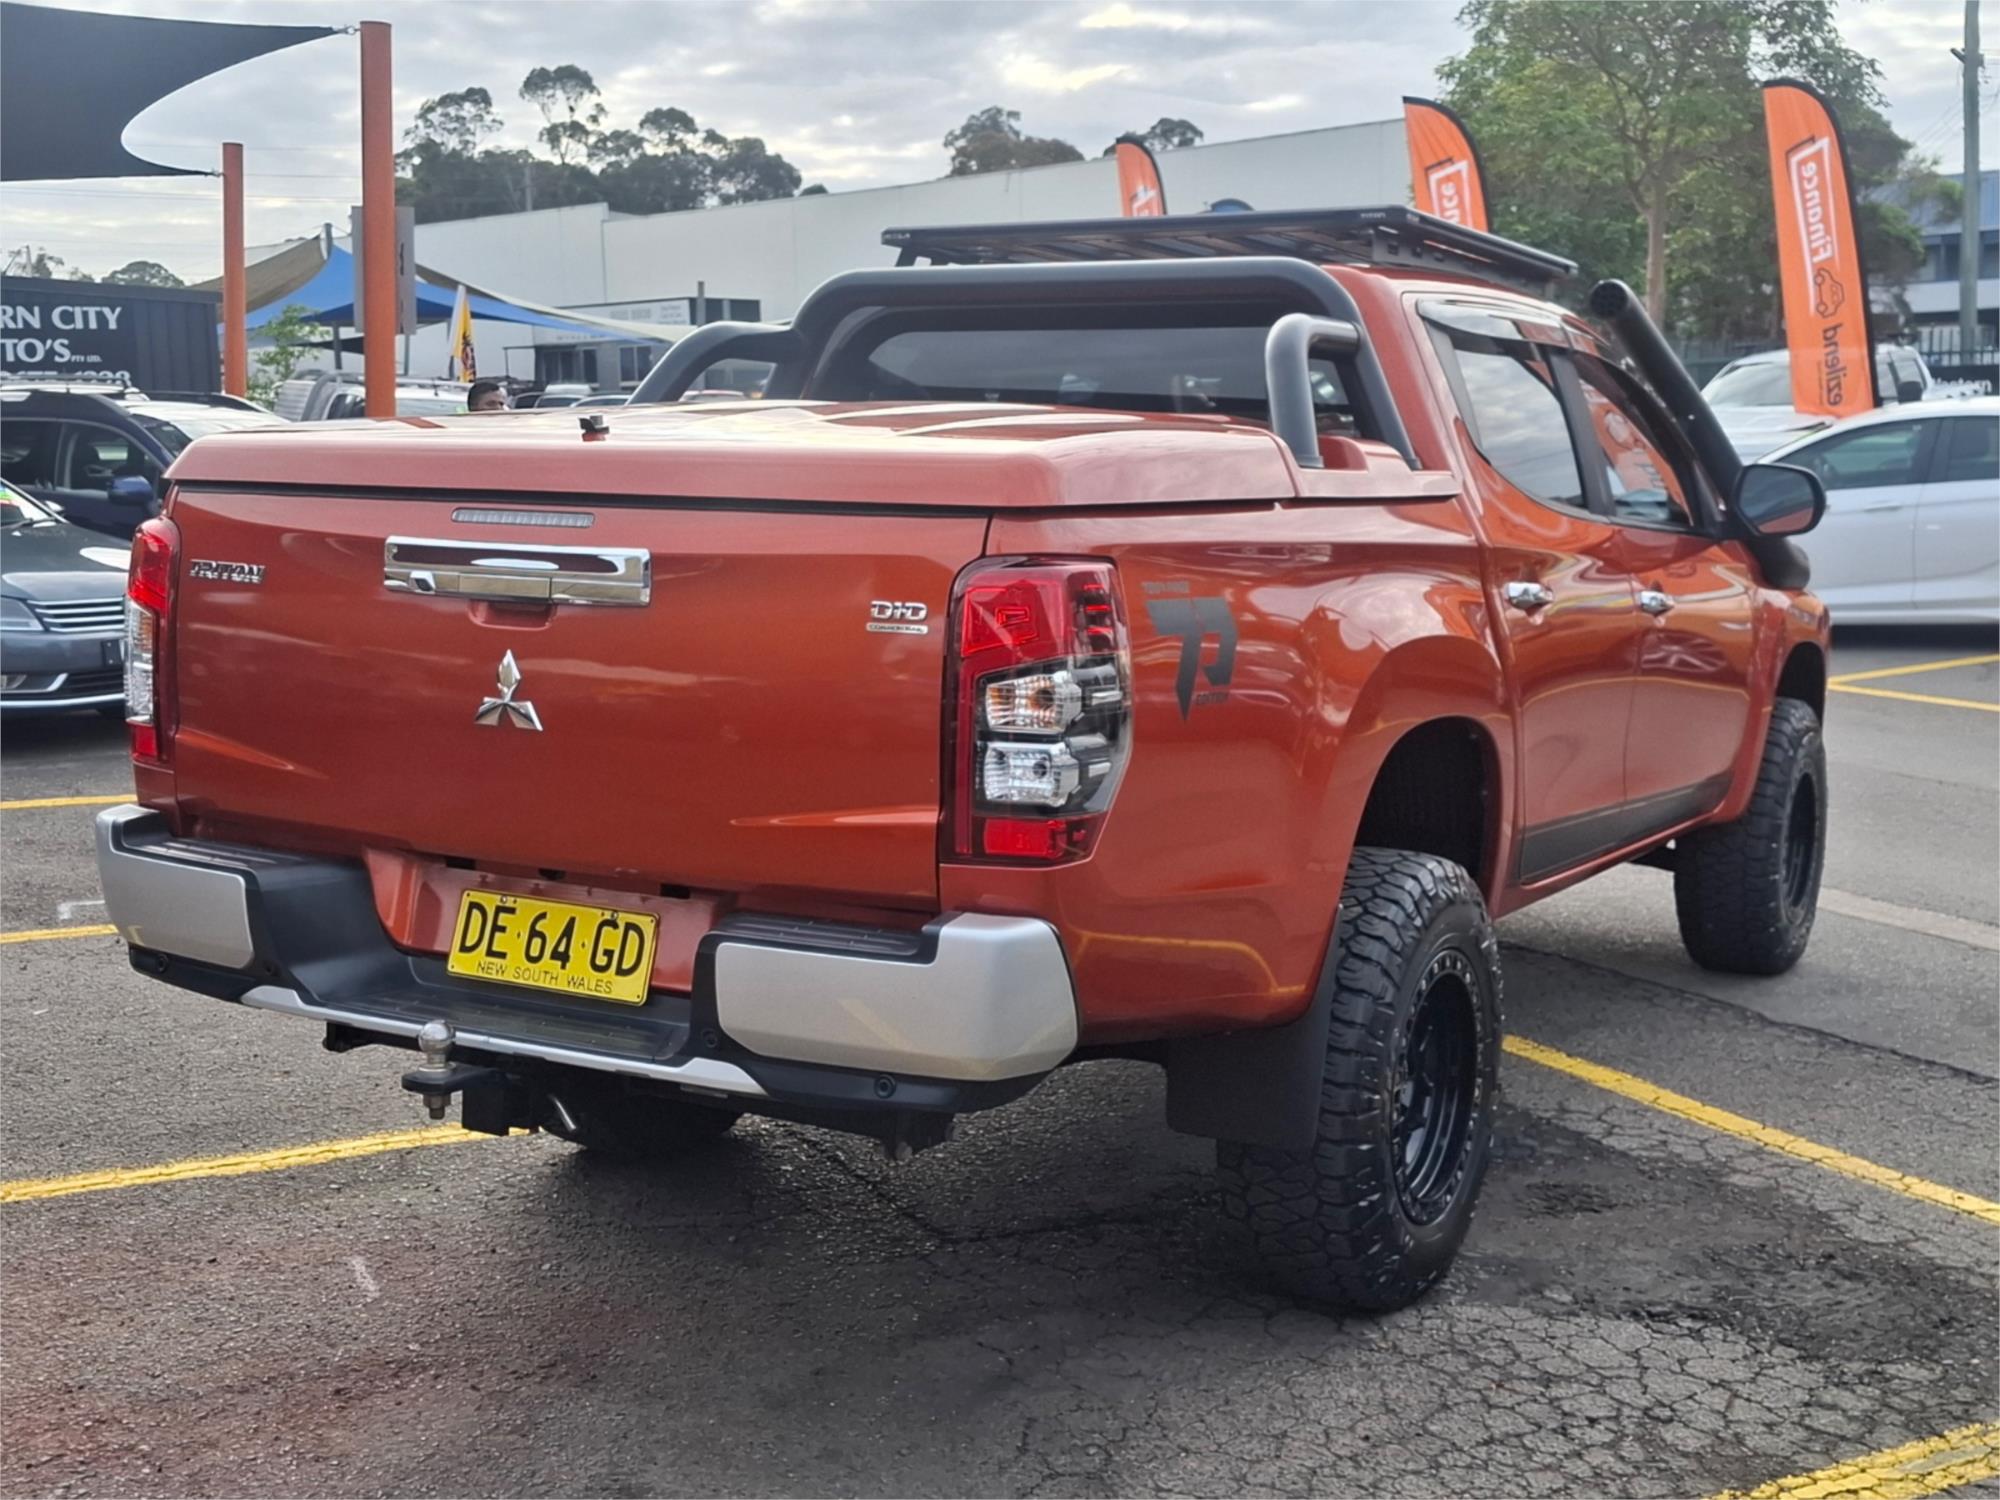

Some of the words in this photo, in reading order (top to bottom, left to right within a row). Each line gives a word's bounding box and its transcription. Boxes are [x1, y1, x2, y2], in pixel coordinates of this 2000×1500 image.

[51, 305, 122, 330] CITY
[190, 559, 266, 584] TRITON
[476, 960, 508, 977] NEW
[513, 966, 560, 986] SOUTH
[567, 975, 614, 994] WALES
